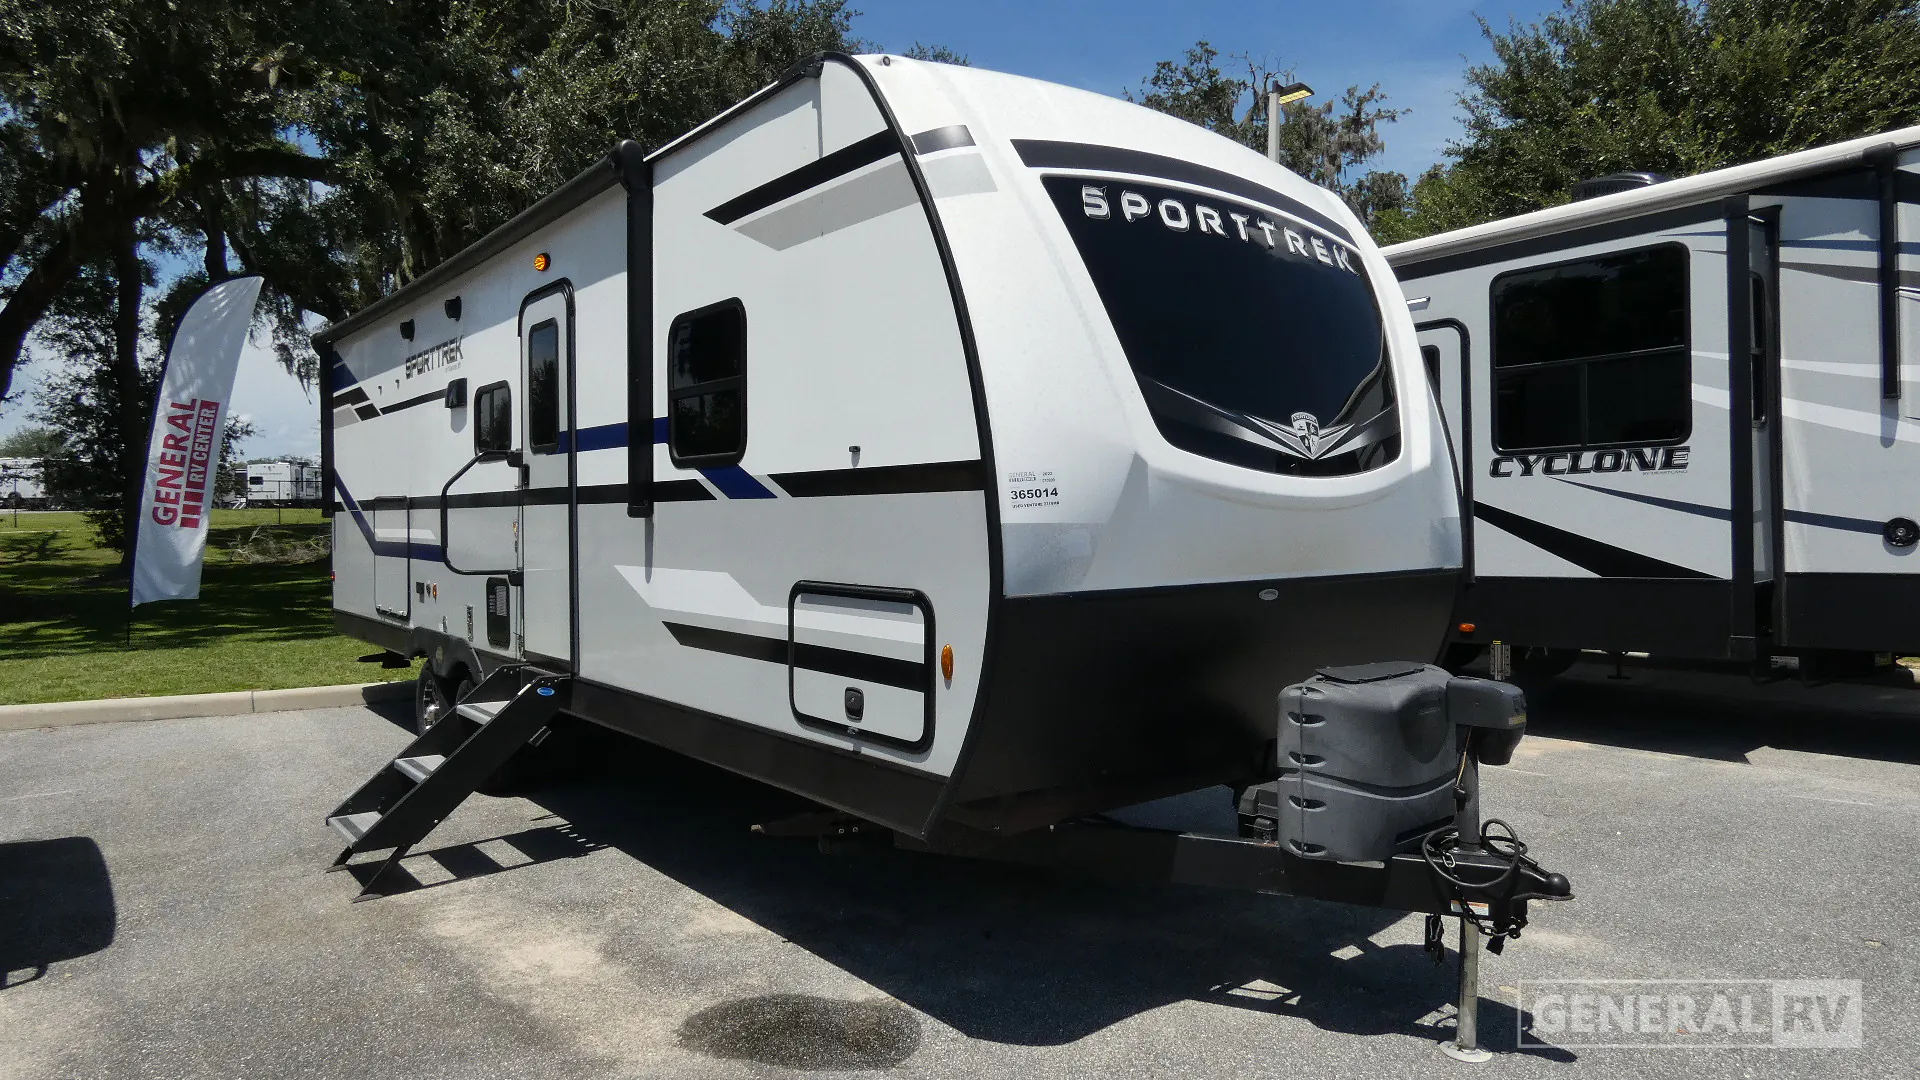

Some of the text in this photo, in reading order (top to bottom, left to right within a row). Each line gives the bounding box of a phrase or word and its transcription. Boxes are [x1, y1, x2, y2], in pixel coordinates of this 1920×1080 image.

[1082, 184, 1359, 276] SPORTTREK
[405, 334, 464, 380] SPORTTREK
[152, 398, 197, 526] GENERAL
[189, 408, 216, 483] RV CENTER
[1489, 446, 1690, 478] CYCLONE
[1010, 487, 1059, 500] 365014
